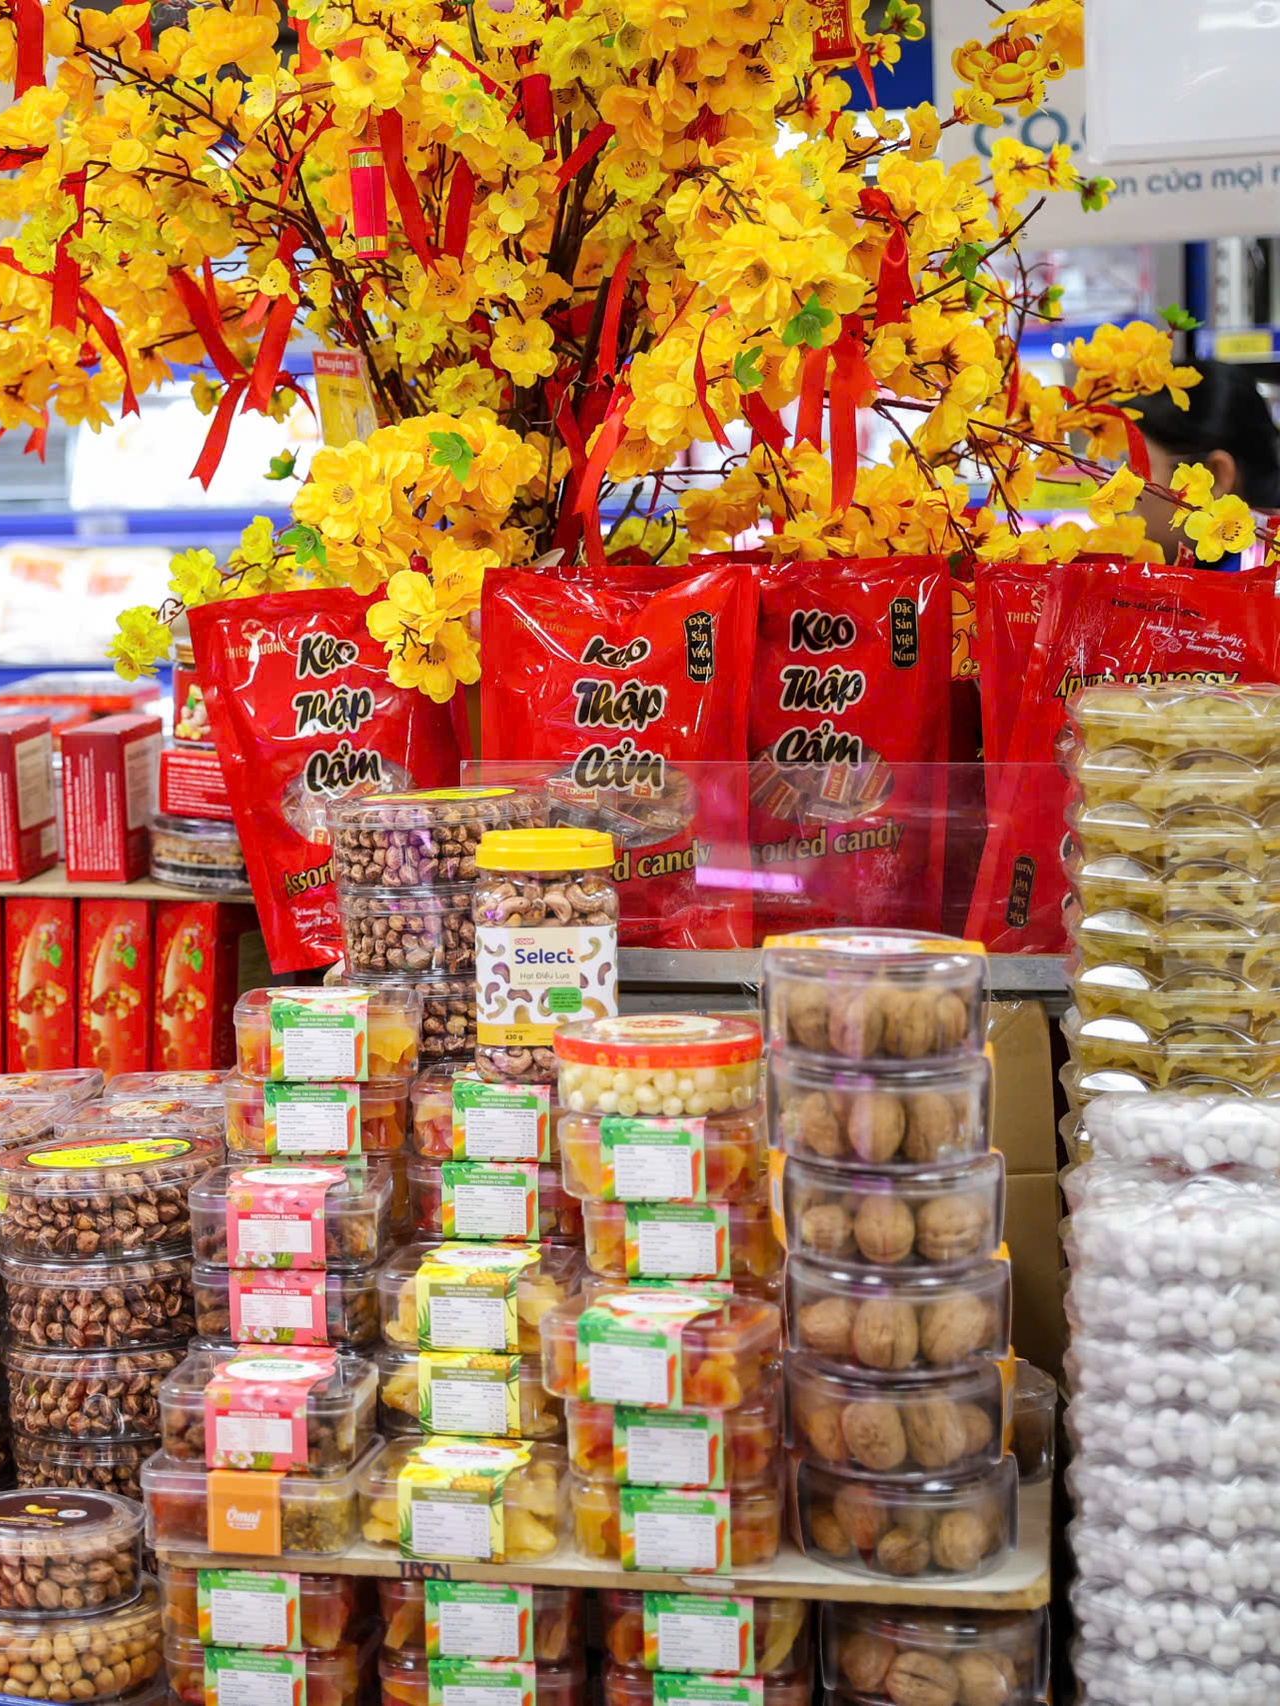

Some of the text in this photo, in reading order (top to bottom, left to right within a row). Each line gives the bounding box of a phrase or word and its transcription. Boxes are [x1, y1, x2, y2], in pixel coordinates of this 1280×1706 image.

[1147, 168, 1202, 194] của
[1212, 161, 1263, 192] mọi
[894, 603, 912, 616] Đặc
[895, 617, 912, 629] Sản
[790, 609, 856, 653] Kẹo
[895, 635, 914, 648] Việt
[297, 632, 358, 679] Kẹo
[581, 636, 651, 669] Kẹo
[689, 664, 712, 675] Nam
[691, 645, 711, 660] Việt
[893, 651, 915, 662] Nam
[294, 686, 374, 733] Thập
[574, 680, 665, 732] Thập
[780, 665, 866, 713] Thập
[574, 739, 665, 790] Cẩm
[773, 720, 862, 771] Cẩm
[306, 741, 382, 792] Cẩm
[637, 838, 713, 877] candy
[751, 816, 905, 865] sorted candy
[283, 856, 336, 899] Assort
[515, 948, 576, 965] Select
